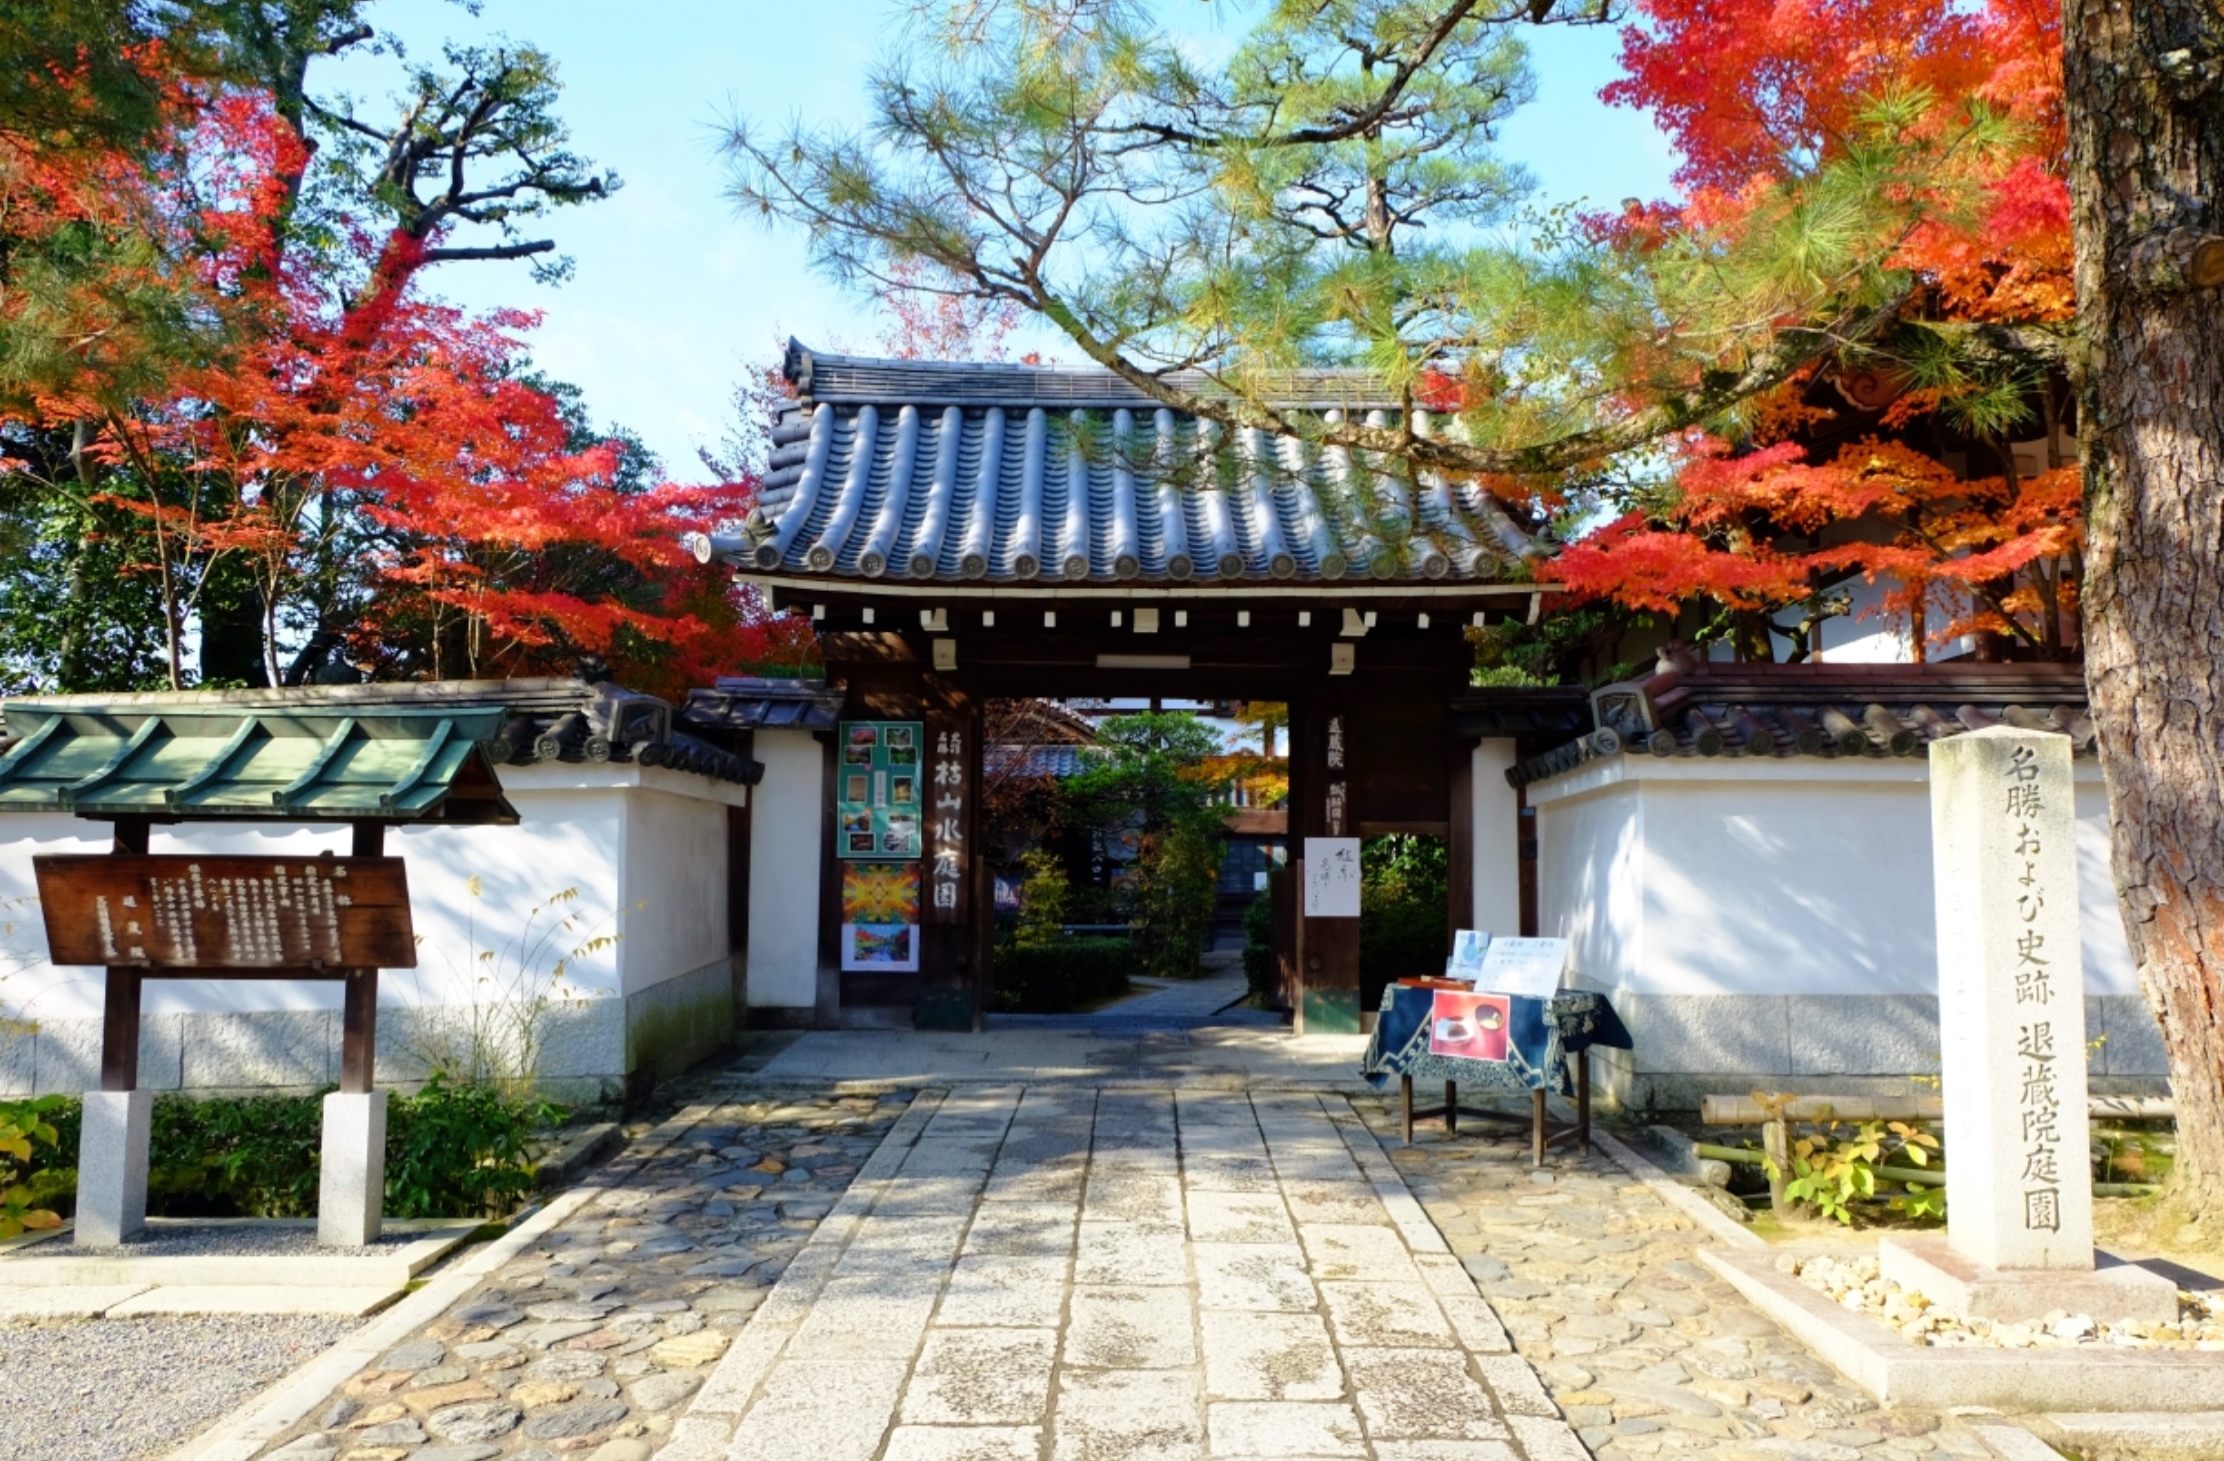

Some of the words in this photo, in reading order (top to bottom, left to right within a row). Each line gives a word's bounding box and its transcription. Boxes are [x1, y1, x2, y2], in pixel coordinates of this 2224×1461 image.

[933, 760, 964, 910] 枯山水庭園
[2003, 745, 2057, 1007] 名勝および史跡
[123, 895, 146, 958] 退蔵院
[2017, 1024, 2063, 1234] 退蔵院庭園
